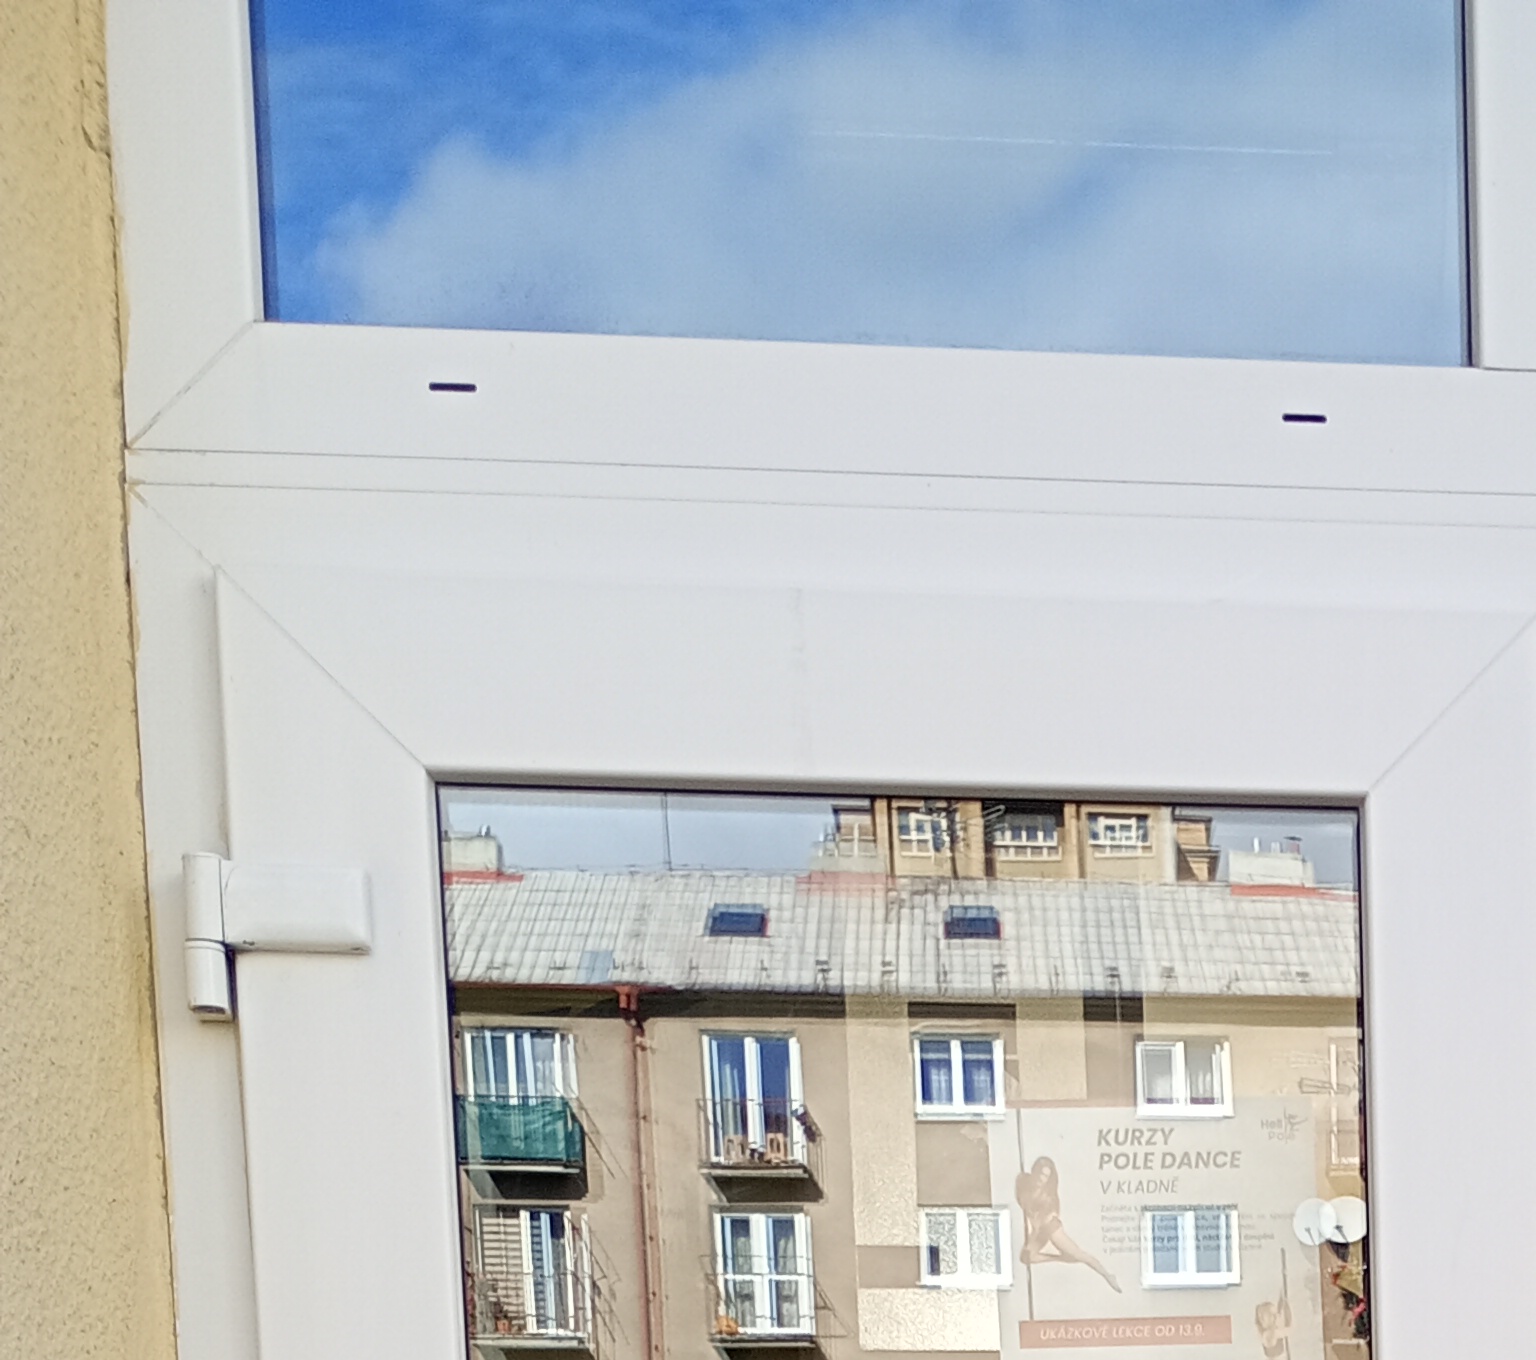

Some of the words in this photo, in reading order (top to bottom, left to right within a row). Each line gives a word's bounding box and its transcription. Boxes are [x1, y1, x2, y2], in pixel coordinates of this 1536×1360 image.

[1097, 1127, 1175, 1147] KURZY
[1099, 1151, 1153, 1170] POLE
[1161, 1150, 1241, 1169] DANCE
[1100, 1180, 1111, 1194] V
[1117, 1177, 1179, 1194] KLADNĚ
[1040, 1325, 1108, 1340] UKÁZKOVÉ
[1112, 1325, 1150, 1338] LEKCE
[1155, 1325, 1174, 1336] OD
